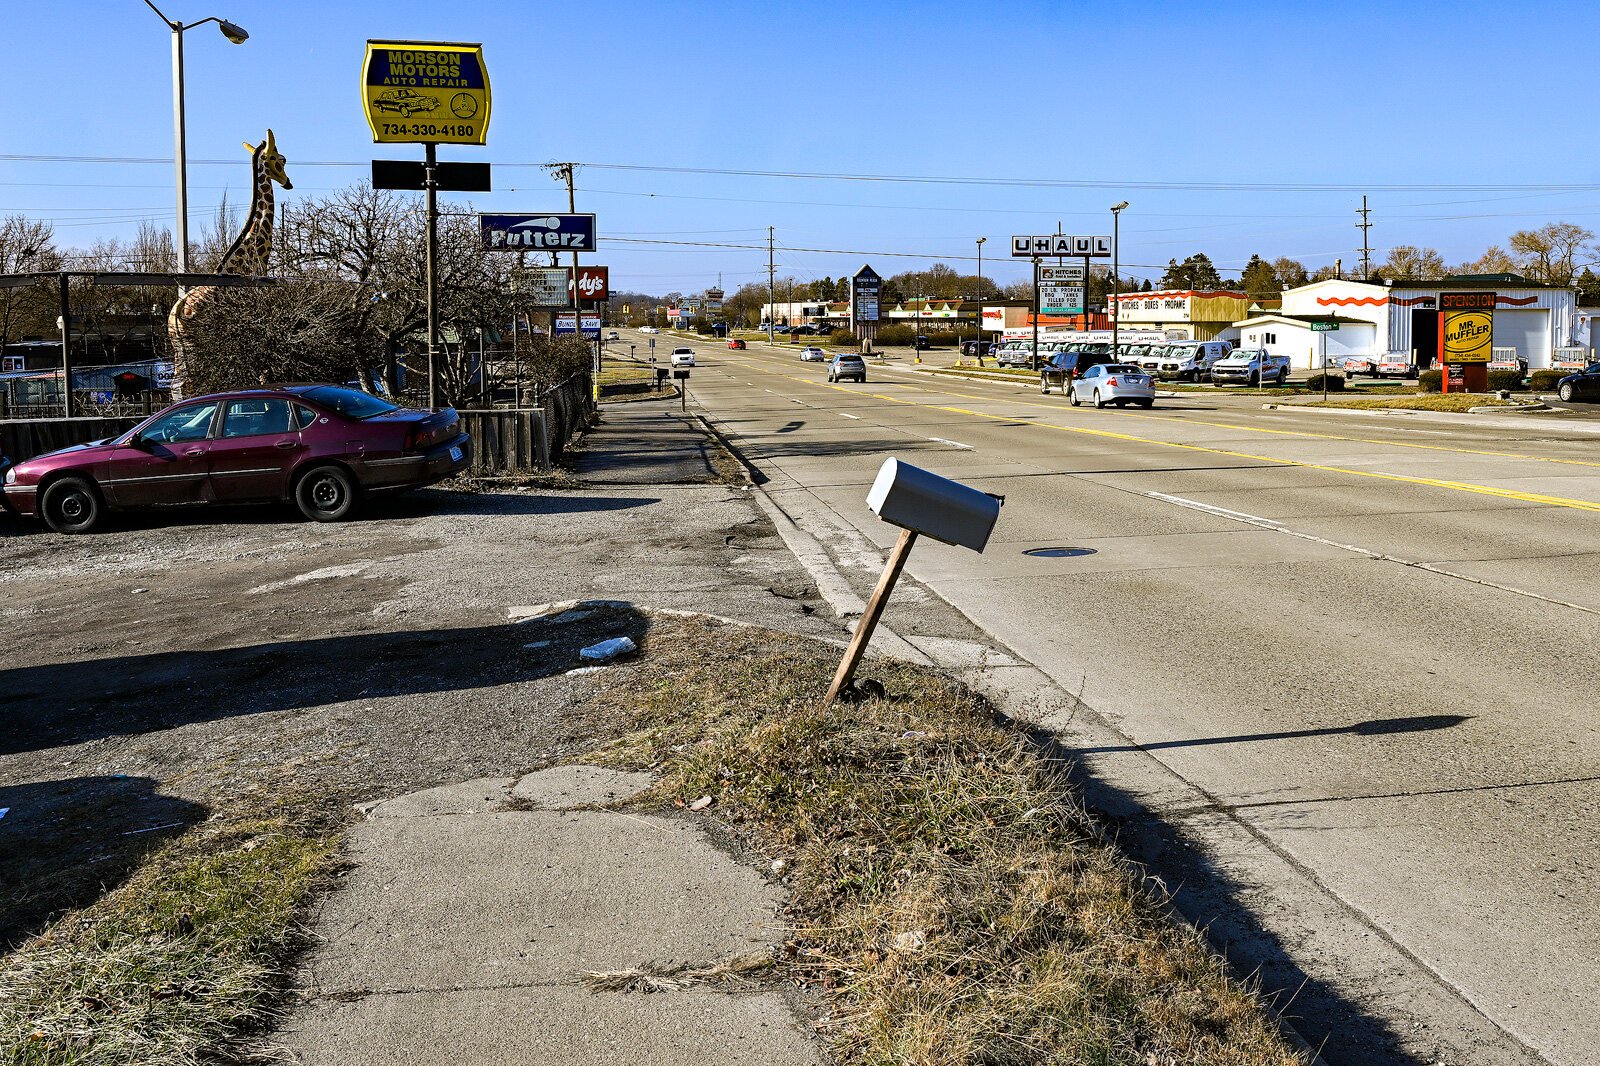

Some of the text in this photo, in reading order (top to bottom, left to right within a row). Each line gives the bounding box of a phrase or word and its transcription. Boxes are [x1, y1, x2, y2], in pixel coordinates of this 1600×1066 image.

[388, 51, 461, 65] MORSON
[389, 64, 461, 77] MOTORS
[383, 77, 468, 87] AUTO REPAIR
[382, 124, 474, 137] 734-330-4180
[491, 230, 586, 248] Putterz
[1121, 299, 1186, 310] HITCHES BOXES PROPANE
[1312, 323, 1333, 331] Boston
[1458, 320, 1476, 331] MR.
[1445, 324, 1490, 343] MUFFLER
